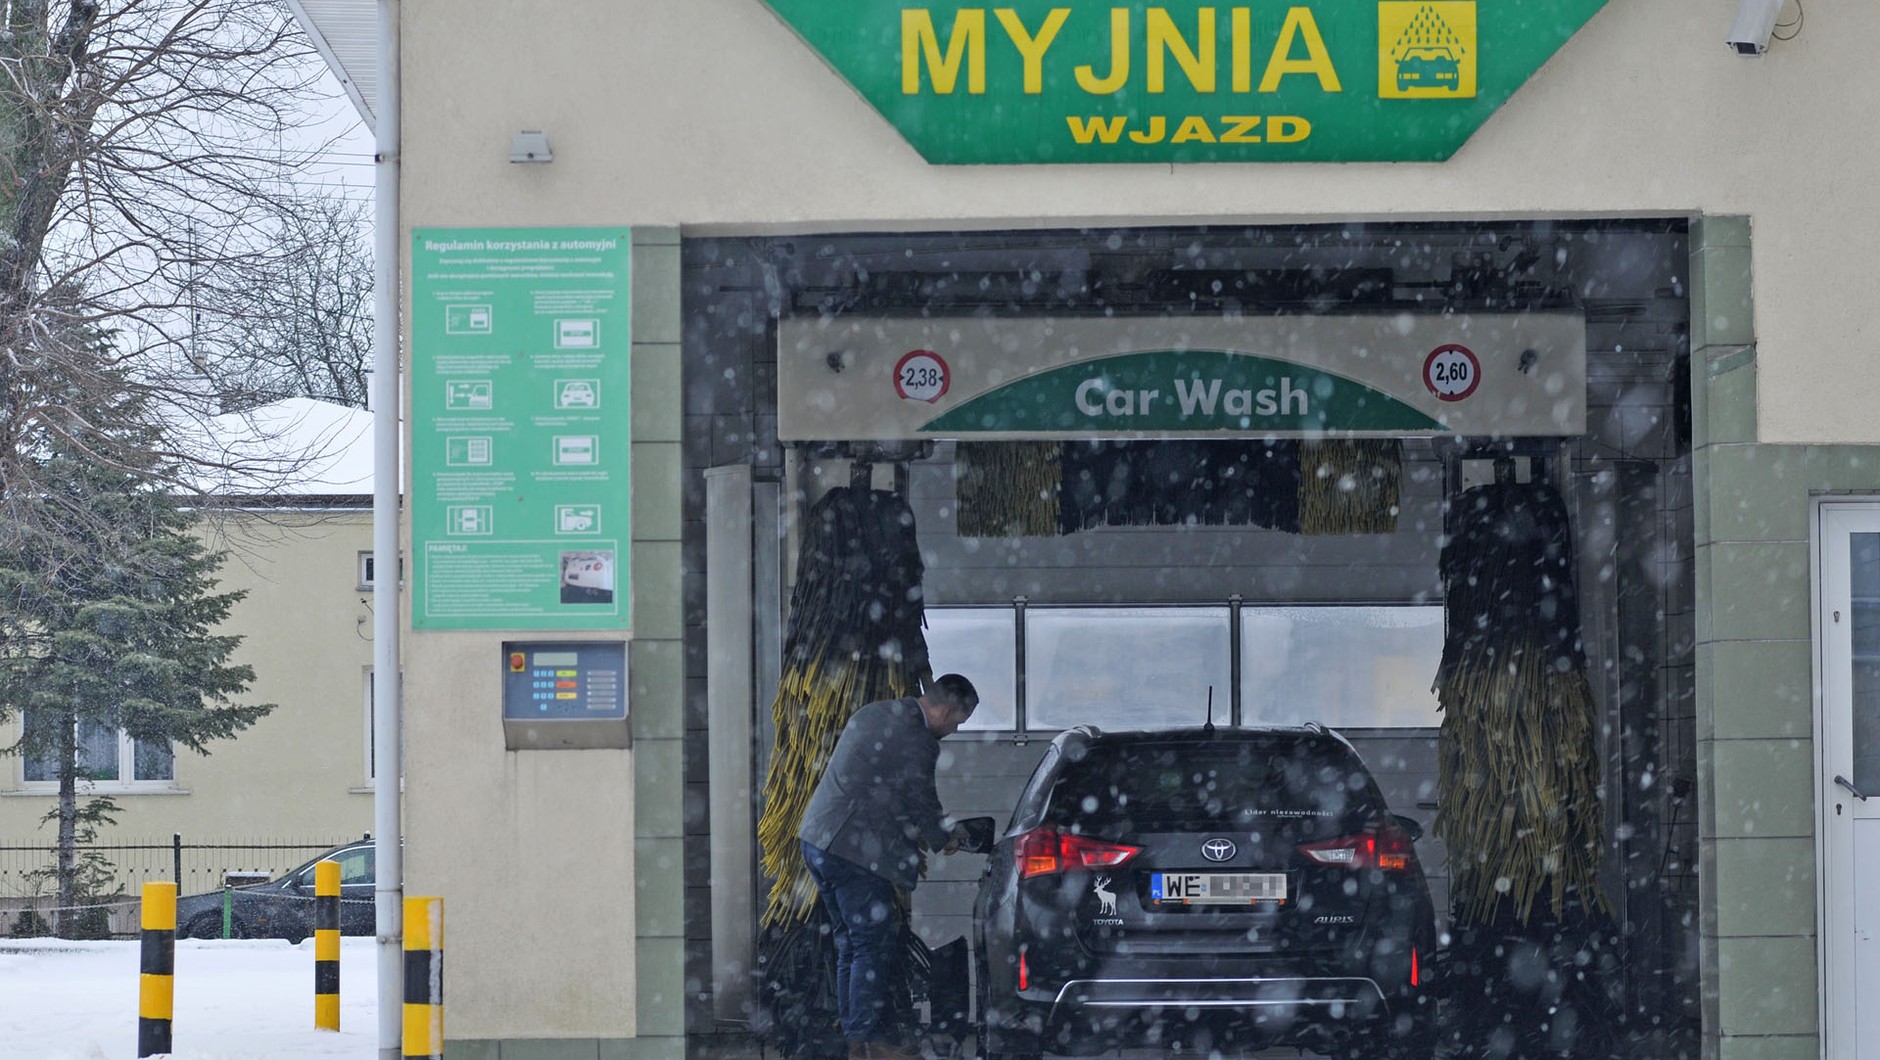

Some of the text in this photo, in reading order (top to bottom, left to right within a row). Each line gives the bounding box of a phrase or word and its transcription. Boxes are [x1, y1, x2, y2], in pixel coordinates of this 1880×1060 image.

[901, 7, 1342, 94] MYJNIA
[1066, 115, 1311, 144] WJAZD
[425, 239, 617, 253] Regulamin korzystania z automyjni
[905, 368, 937, 390] 2,38
[1436, 362, 1467, 385] 2,60
[1075, 377, 1308, 416] Car Wash
[1152, 889, 1162, 897] PL
[1093, 918, 1124, 926] TOYOTA
[1314, 915, 1355, 924] AURIS
